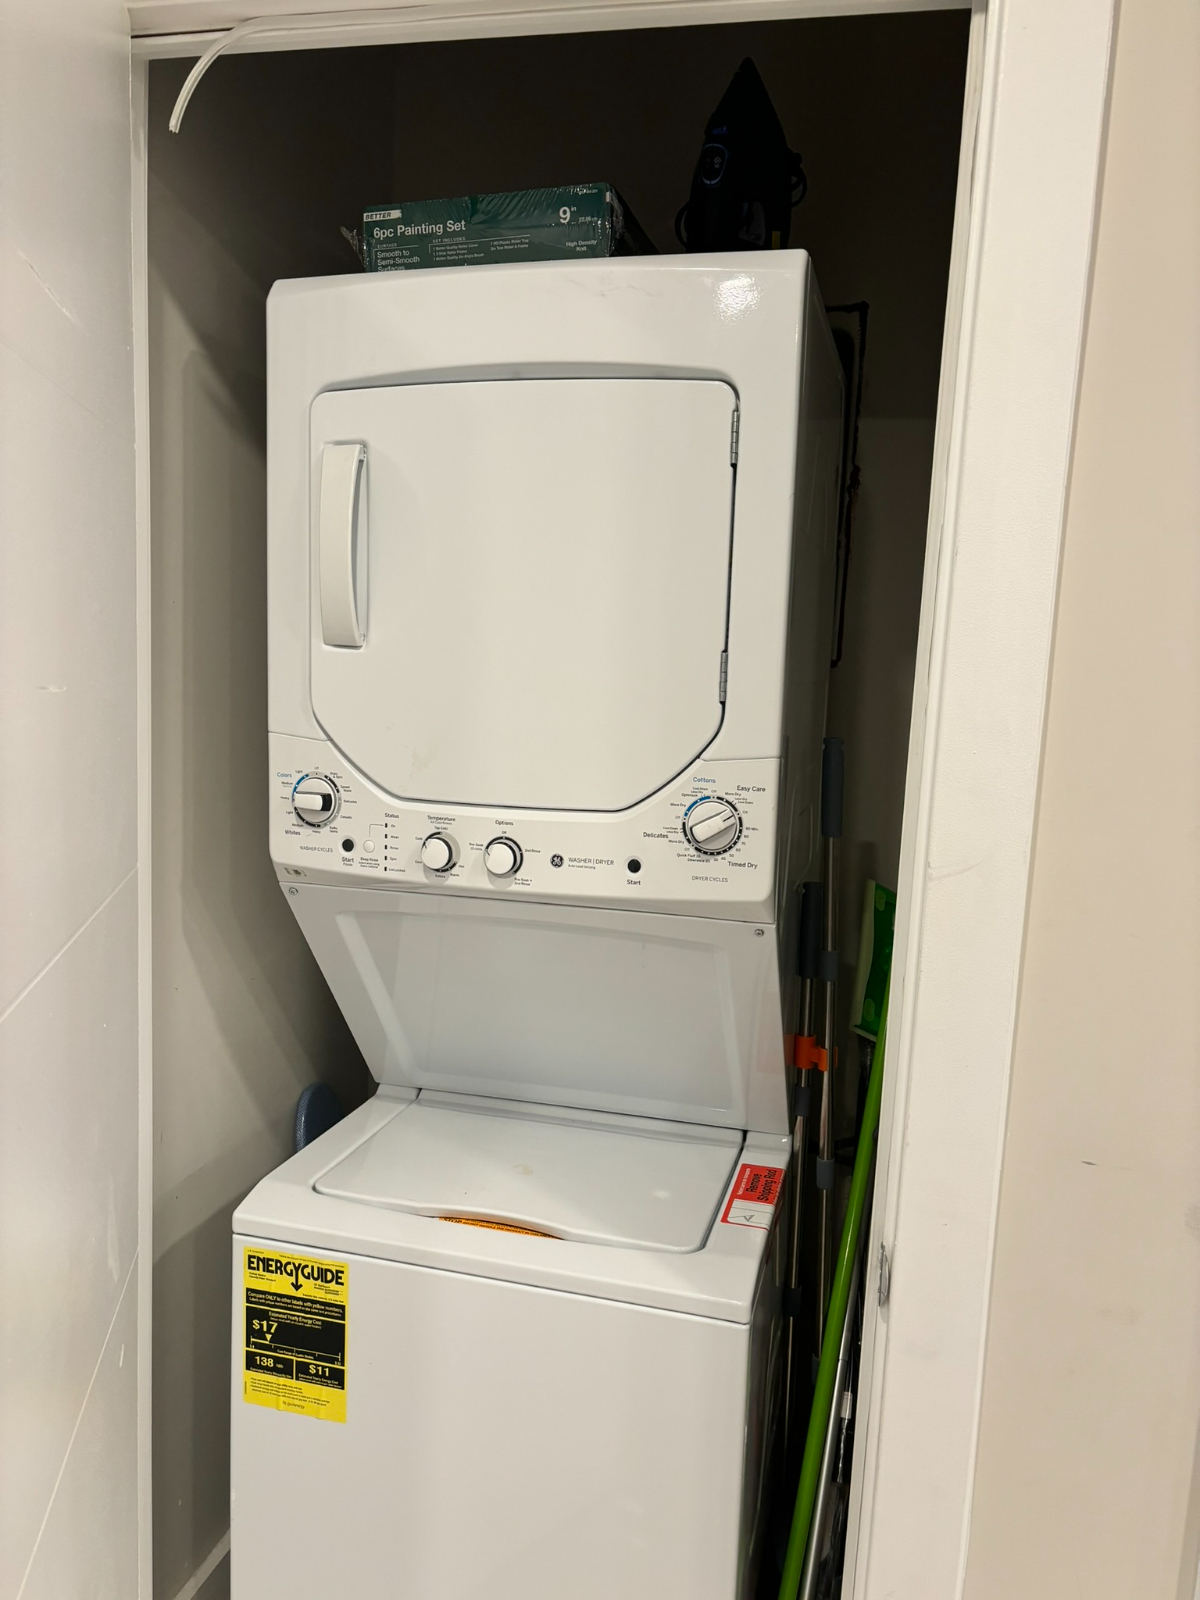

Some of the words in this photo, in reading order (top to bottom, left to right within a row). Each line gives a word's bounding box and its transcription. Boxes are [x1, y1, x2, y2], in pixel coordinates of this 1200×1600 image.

[364, 212, 392, 221] BETTER
[559, 206, 570, 223] 9
[373, 227, 394, 240] 6pc
[397, 223, 443, 236] Painting
[446, 219, 466, 232] Set
[377, 250, 402, 258] Smooth
[377, 257, 420, 266] Semi-Smooth
[764, 1168, 777, 1179] Rod
[746, 1173, 762, 1193] Remove
[757, 1180, 777, 1201] Shipping
[248, 1254, 345, 1287] ENERGYGUIDE
[247, 1291, 265, 1299] Compare
[269, 1311, 287, 1319] Estimated
[299, 1316, 312, 1324] Energy
[252, 1319, 278, 1333] $17
[255, 1356, 274, 1368] 138
[309, 1364, 329, 1377] $11
